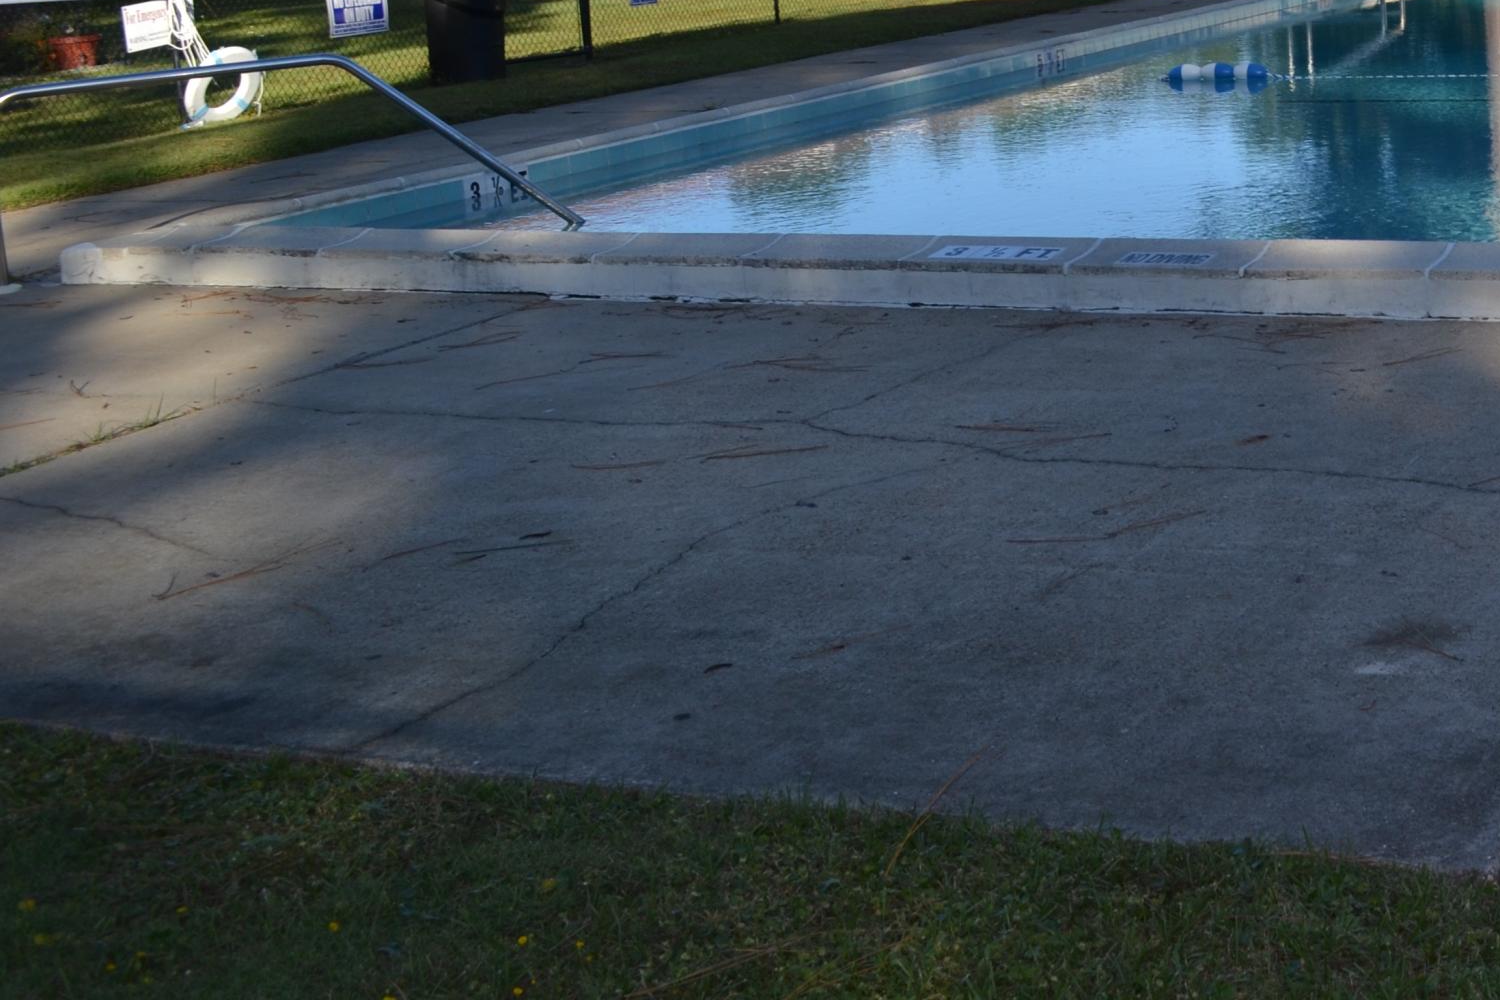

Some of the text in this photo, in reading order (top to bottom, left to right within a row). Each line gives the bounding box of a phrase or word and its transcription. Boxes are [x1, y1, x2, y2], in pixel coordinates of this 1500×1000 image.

[944, 246, 970, 257] 3
[1014, 247, 1060, 259] FT
[1121, 252, 1211, 265] NO DIVING
